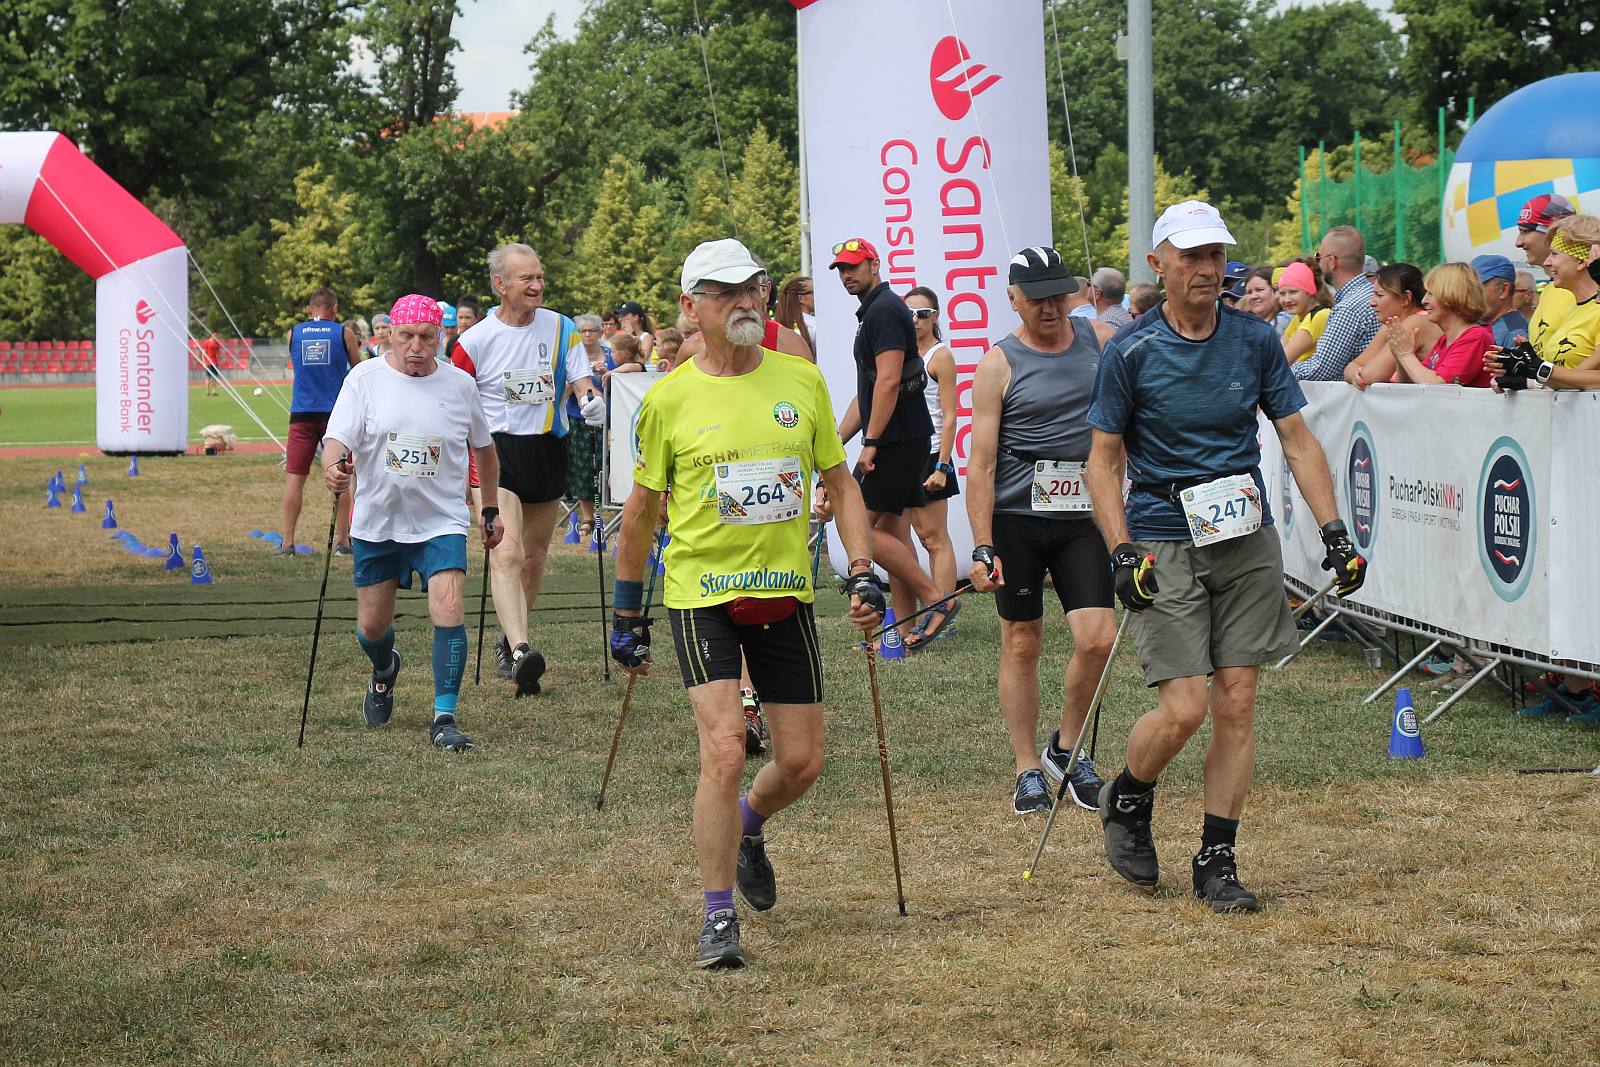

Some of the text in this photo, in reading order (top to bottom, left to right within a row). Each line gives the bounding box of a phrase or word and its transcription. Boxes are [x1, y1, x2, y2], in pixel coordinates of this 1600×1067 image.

[937, 136, 999, 477] Santan
[302, 326, 331, 334] pfnw.eu
[119, 328, 132, 432] Consumer Bank
[136, 329, 154, 435] Santander
[518, 381, 544, 395] 271
[400, 449, 428, 465] 251
[693, 448, 740, 468] KGHM
[741, 482, 785, 506] 264
[1049, 479, 1080, 496] 201
[1389, 475, 1464, 519] PucharPolskiNW.pl
[1208, 497, 1246, 523] 247
[1494, 494, 1520, 514] PUCHAR
[1494, 513, 1520, 537] POLSKI
[444, 638, 465, 688] Kalenji
